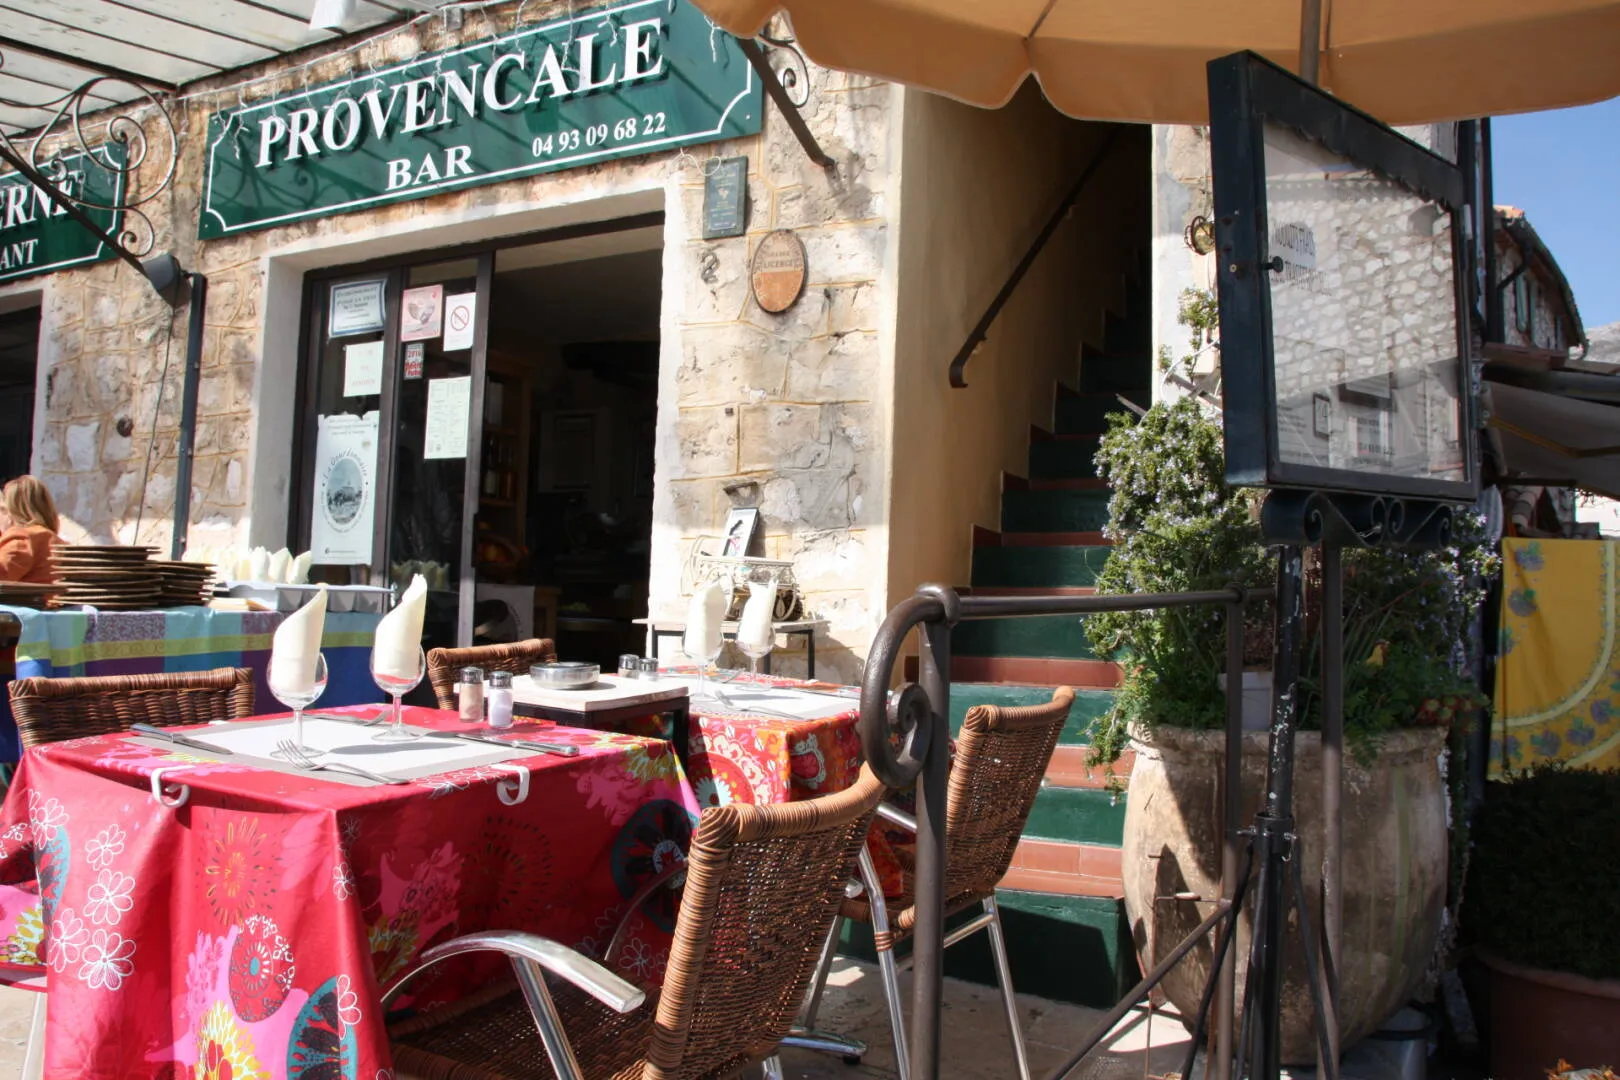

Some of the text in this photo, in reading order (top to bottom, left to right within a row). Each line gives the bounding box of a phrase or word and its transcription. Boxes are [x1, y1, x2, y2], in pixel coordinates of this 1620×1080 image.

[255, 17, 663, 168] PROVENCALE
[532, 112, 666, 157] 04 93 09 68 22
[385, 145, 475, 191] BAR
[0, 238, 39, 270] ANT
